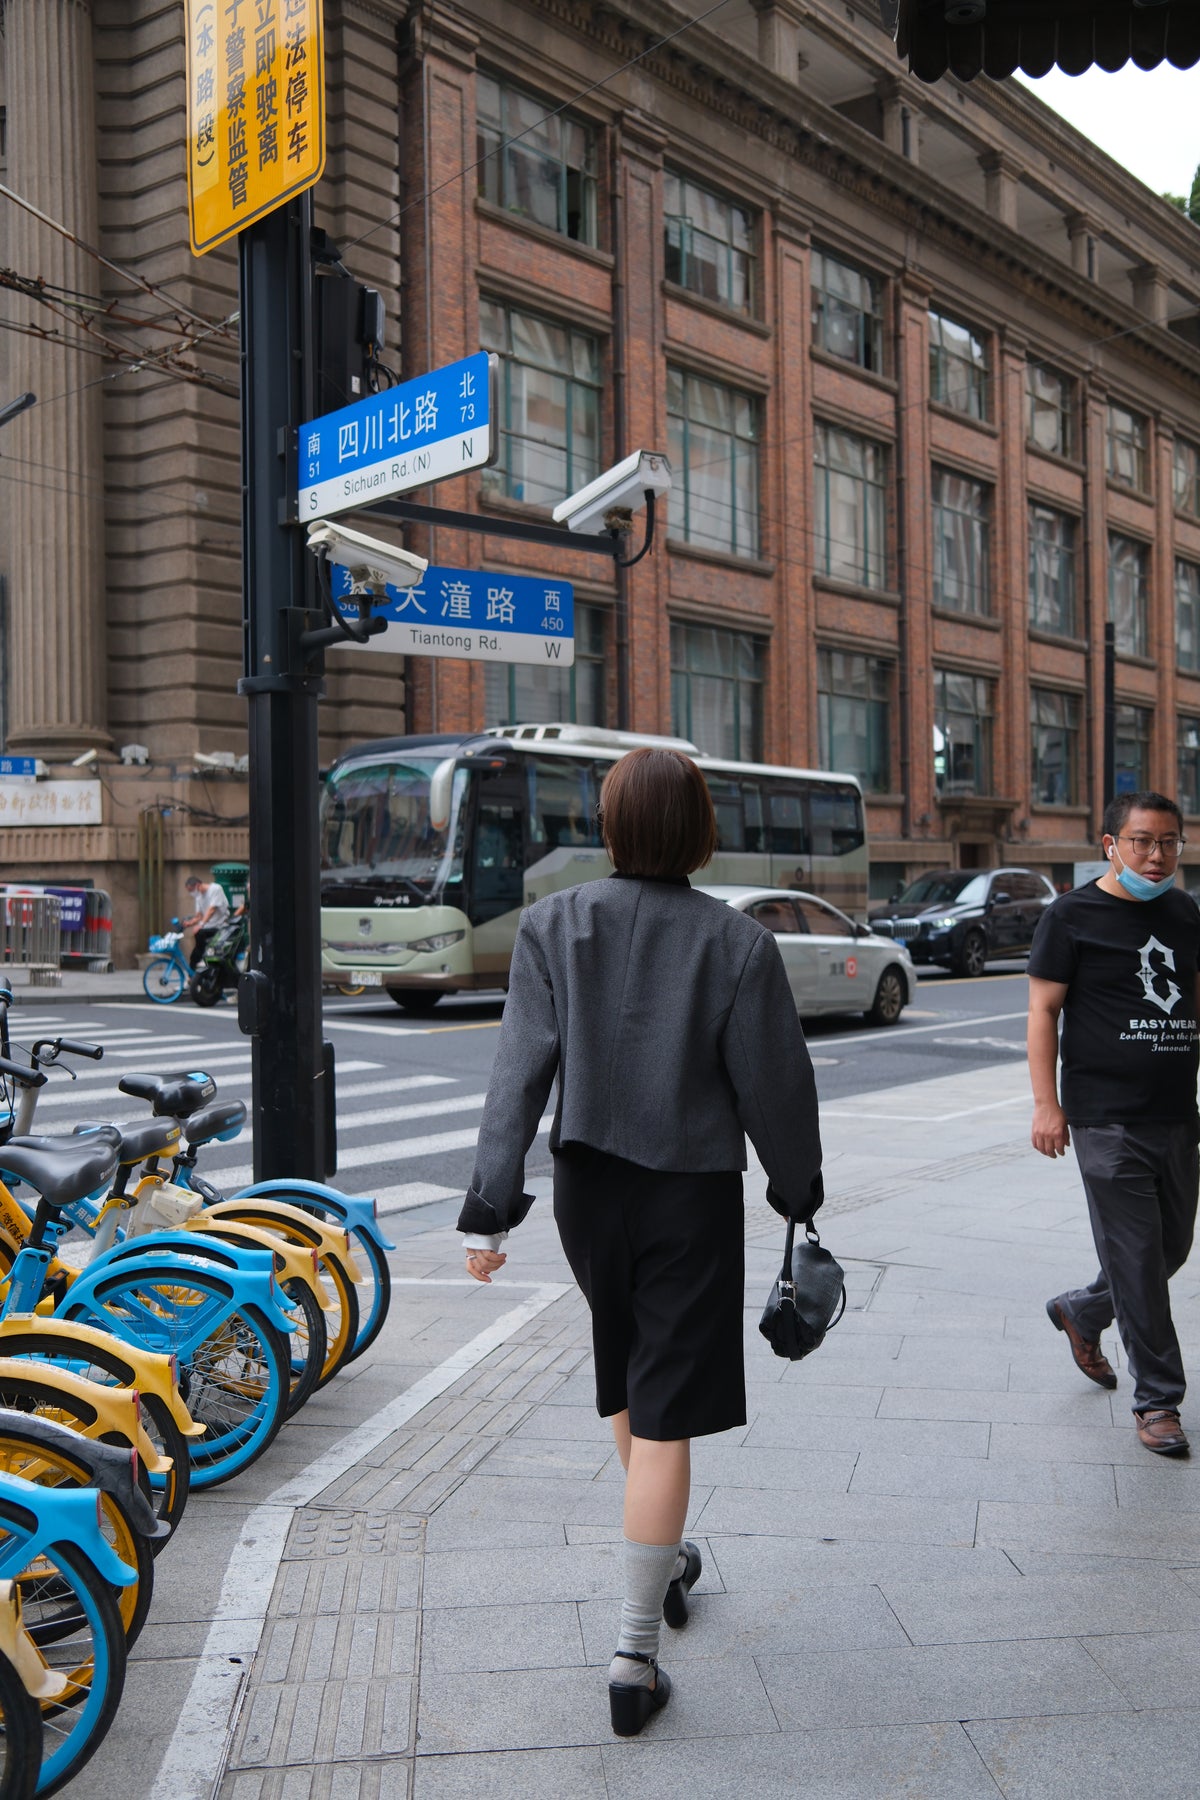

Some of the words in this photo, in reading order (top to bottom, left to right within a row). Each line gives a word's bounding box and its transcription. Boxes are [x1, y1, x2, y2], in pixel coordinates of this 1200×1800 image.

[254, 0, 279, 172] 立即驶离
[459, 371, 476, 399] 北
[460, 403, 475, 423] 73
[338, 390, 439, 464] 四川北路
[307, 432, 321, 458] 南
[462, 437, 473, 461] N
[308, 460, 320, 479] 51
[344, 471, 386, 496] Sichuan
[309, 491, 318, 511] S
[543, 589, 561, 612] 西
[540, 617, 564, 631] 450
[410, 630, 472, 651] Tiantong
[479, 634, 502, 650] Rd.
[545, 642, 561, 659] W
[1129, 1019, 1166, 1029] EASY
[1169, 1019, 1197, 1029] WEAR
[1119, 1031, 1158, 1042] Looking
[1160, 1032, 1175, 1042] for
[1176, 1032, 1188, 1040] the
[1151, 1043, 1190, 1052] Innovate
